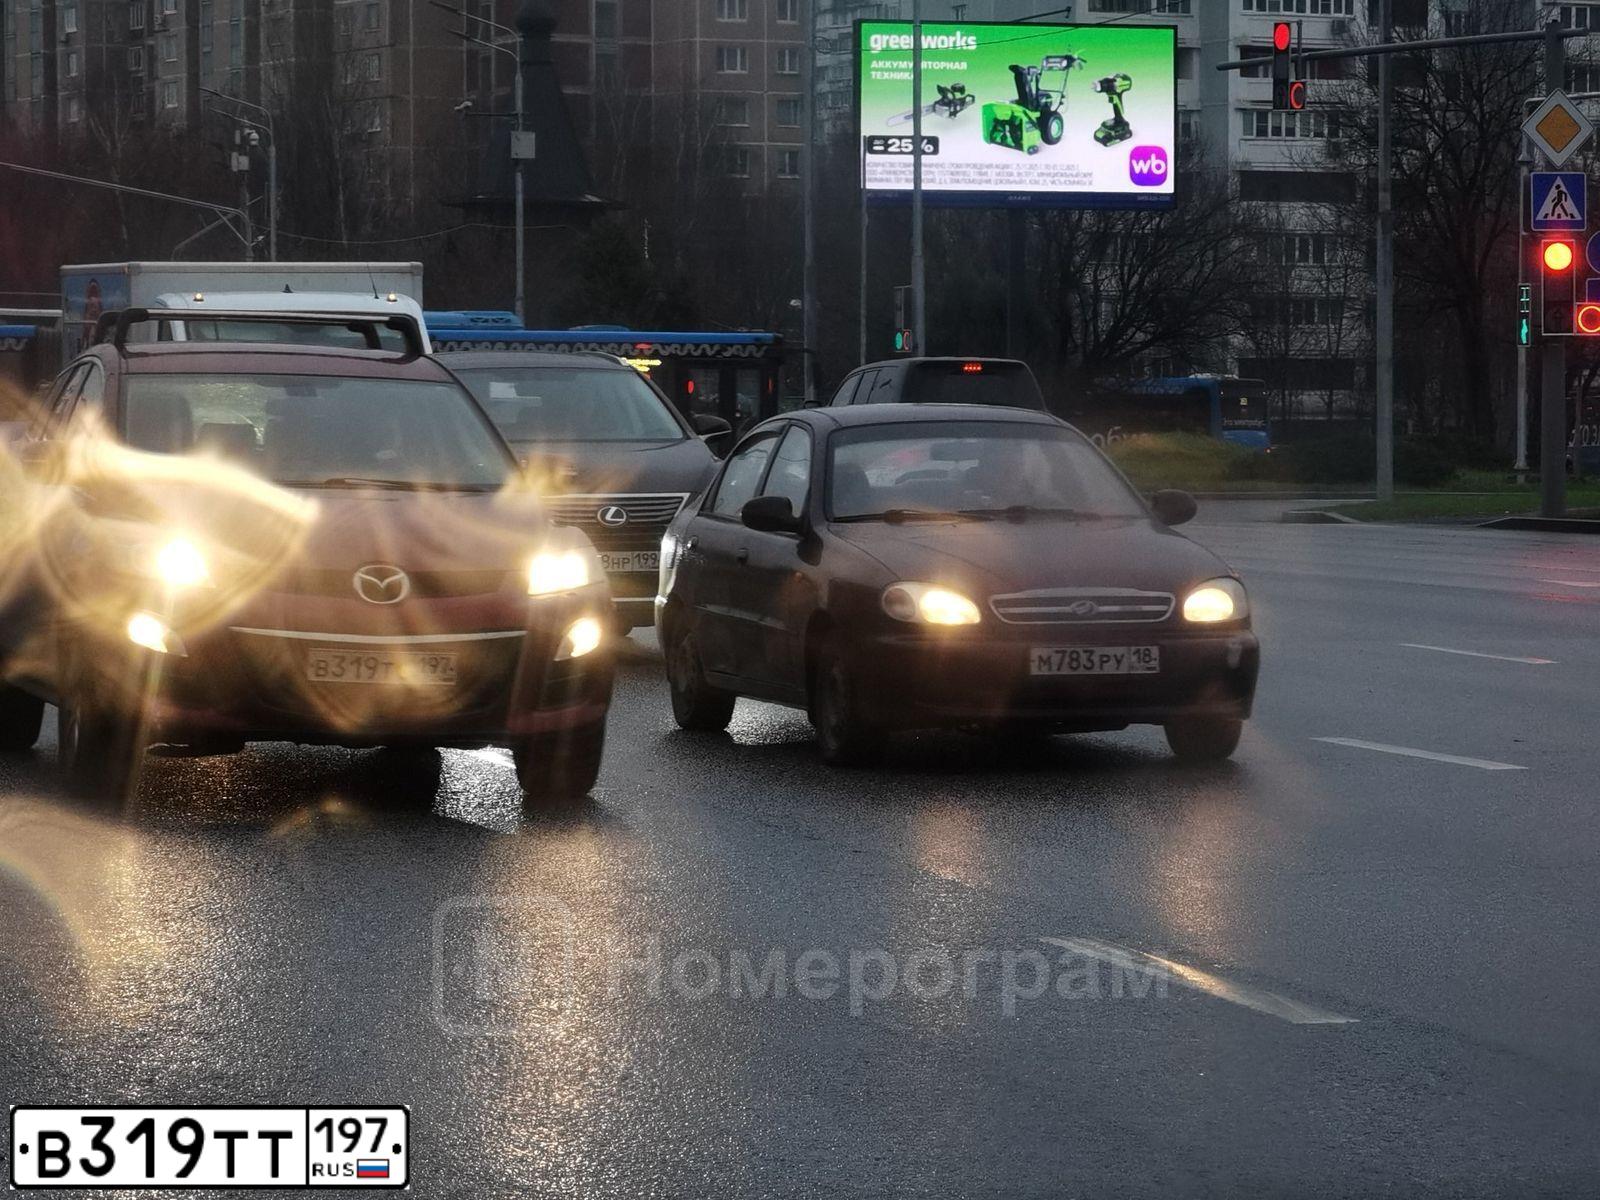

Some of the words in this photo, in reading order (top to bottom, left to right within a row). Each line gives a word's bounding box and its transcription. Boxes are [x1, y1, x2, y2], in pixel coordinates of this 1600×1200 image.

[870, 31, 977, 53] greeworks
[870, 60, 968, 70] АККУМУЯТОРНАЯ
[870, 71, 914, 80] ТЕХНИК
[1131, 153, 1167, 175] wb
[315, 655, 404, 679] В319Т
[1037, 650, 1125, 671] М783РУ
[1132, 648, 1151, 664] 18
